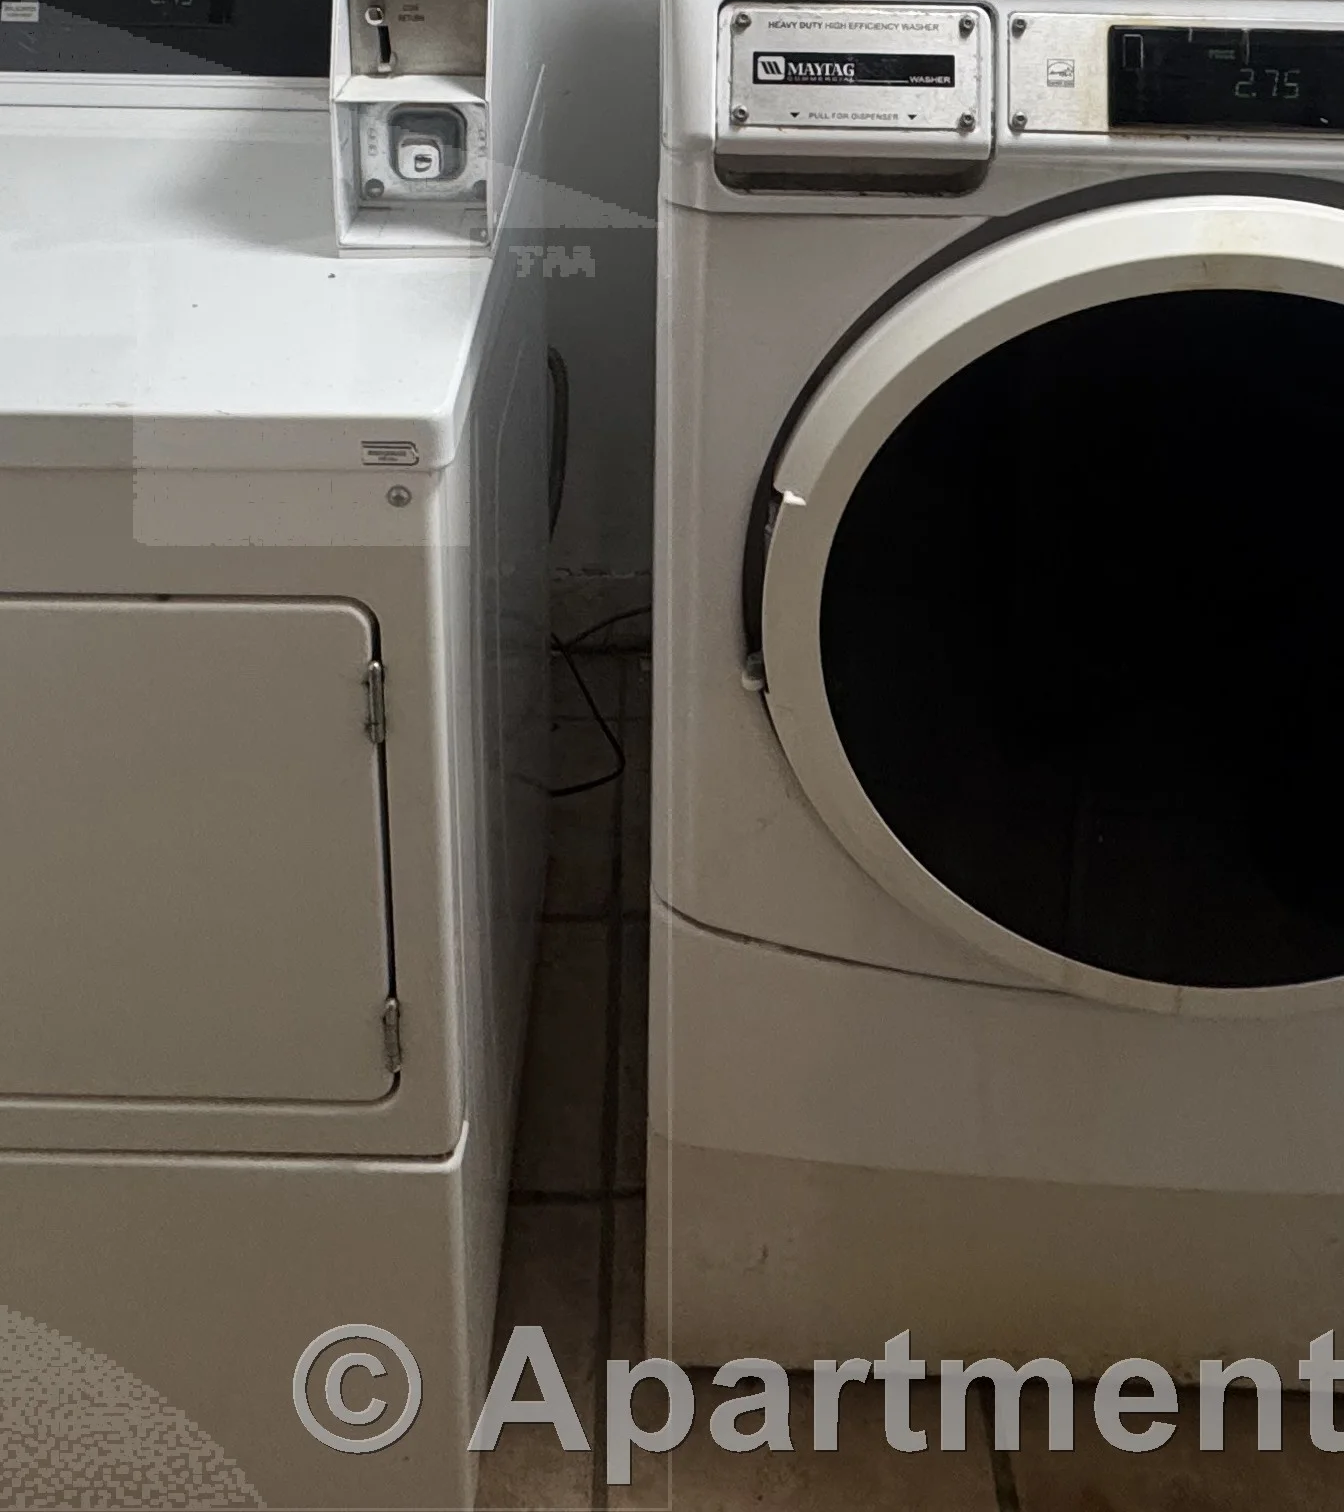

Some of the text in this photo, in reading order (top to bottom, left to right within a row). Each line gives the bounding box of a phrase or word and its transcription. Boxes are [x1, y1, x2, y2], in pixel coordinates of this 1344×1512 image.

[768, 21, 939, 31] HEAVY DUTY HIGH EFFICIENCY WASHER
[787, 62, 855, 77] MAYTAG
[909, 76, 951, 84] WASHER
[1235, 68, 1301, 99] 2.75
[851, 113, 899, 121] DISPENSER
